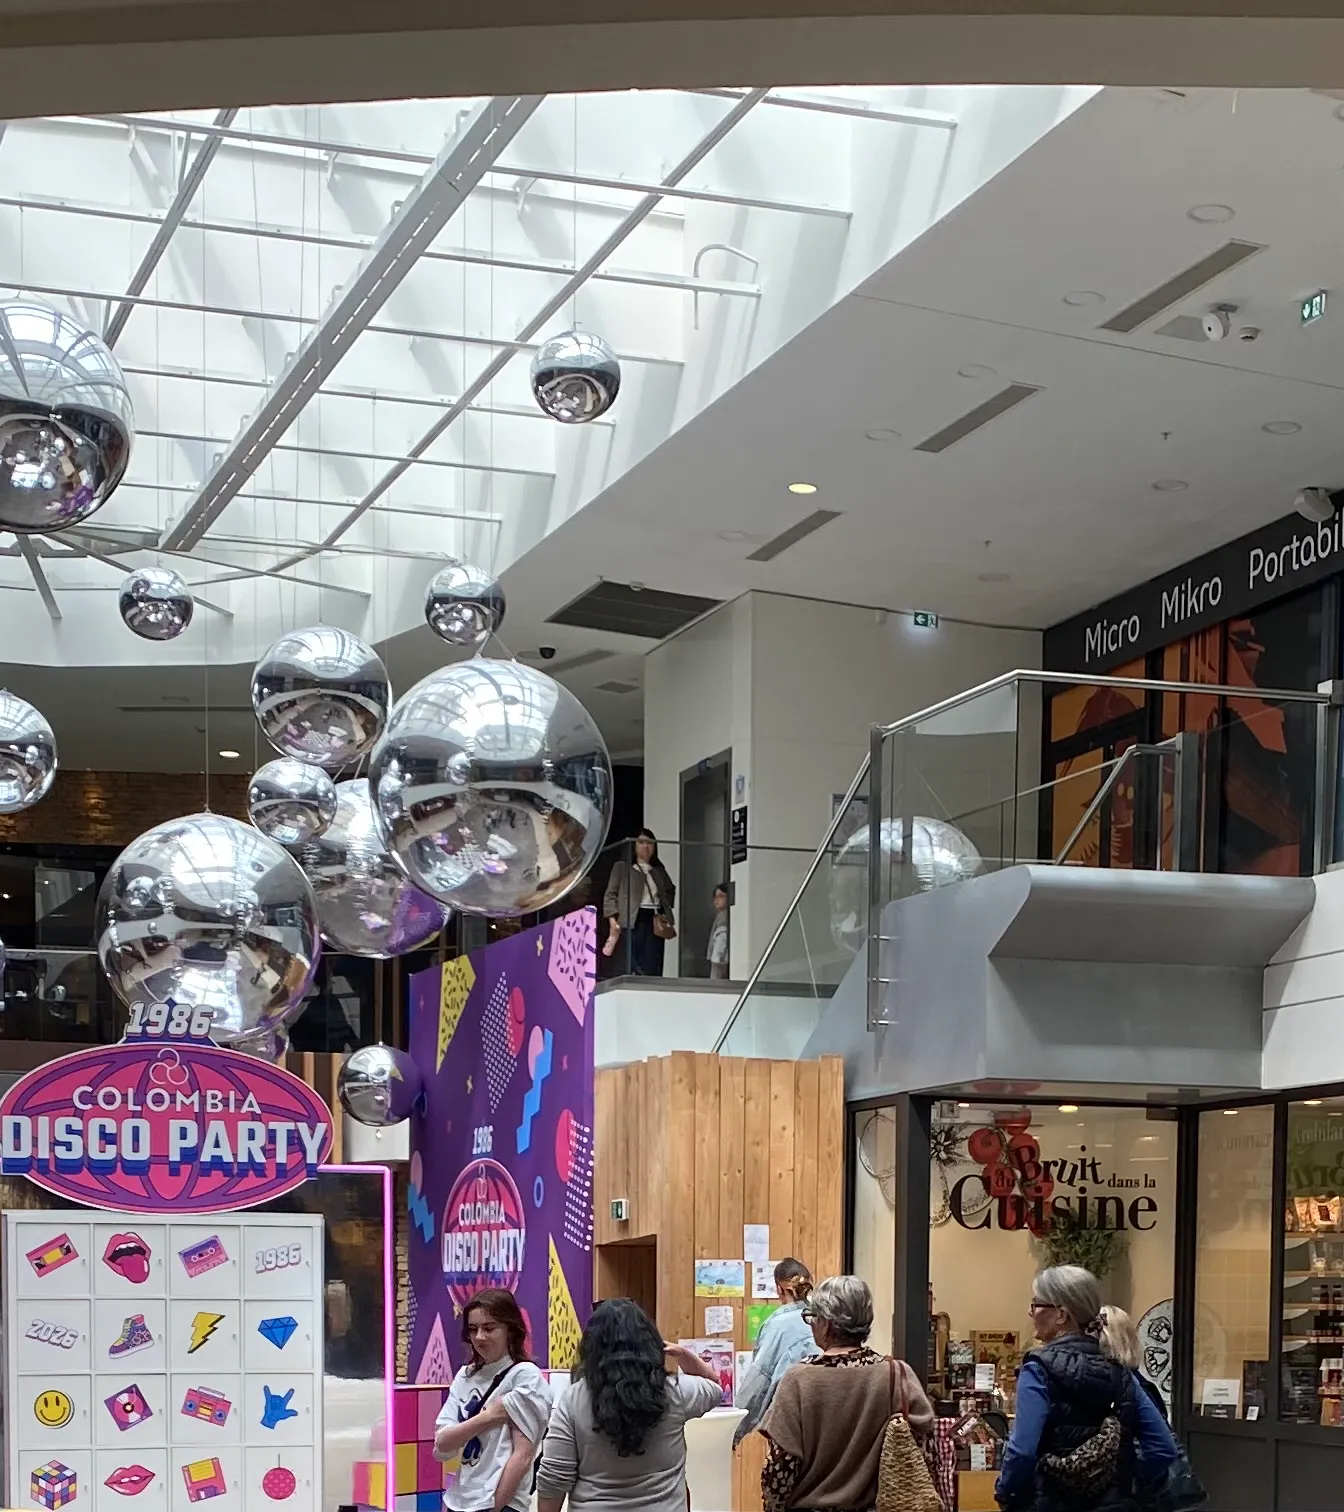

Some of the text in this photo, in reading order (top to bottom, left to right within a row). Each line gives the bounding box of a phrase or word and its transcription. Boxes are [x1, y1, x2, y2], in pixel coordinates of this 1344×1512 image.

[1084, 614, 1140, 663] Micro
[1160, 576, 1223, 629] Mikro
[126, 1001, 214, 1036] 1986
[72, 1085, 263, 1116] COLOMBIA
[2, 1115, 329, 1167] DISCO PARTY
[472, 1125, 494, 1155] 1986
[1014, 1144, 1105, 1188] Bruit
[1107, 1173, 1140, 1189] dans
[1143, 1173, 1157, 1189] la
[458, 1200, 506, 1227] COLOMBIA
[949, 1173, 1158, 1232] Cuisine
[256, 1243, 302, 1274] 1986
[443, 1228, 525, 1273] DISCO PARTY
[25, 1318, 79, 1350] 2026
